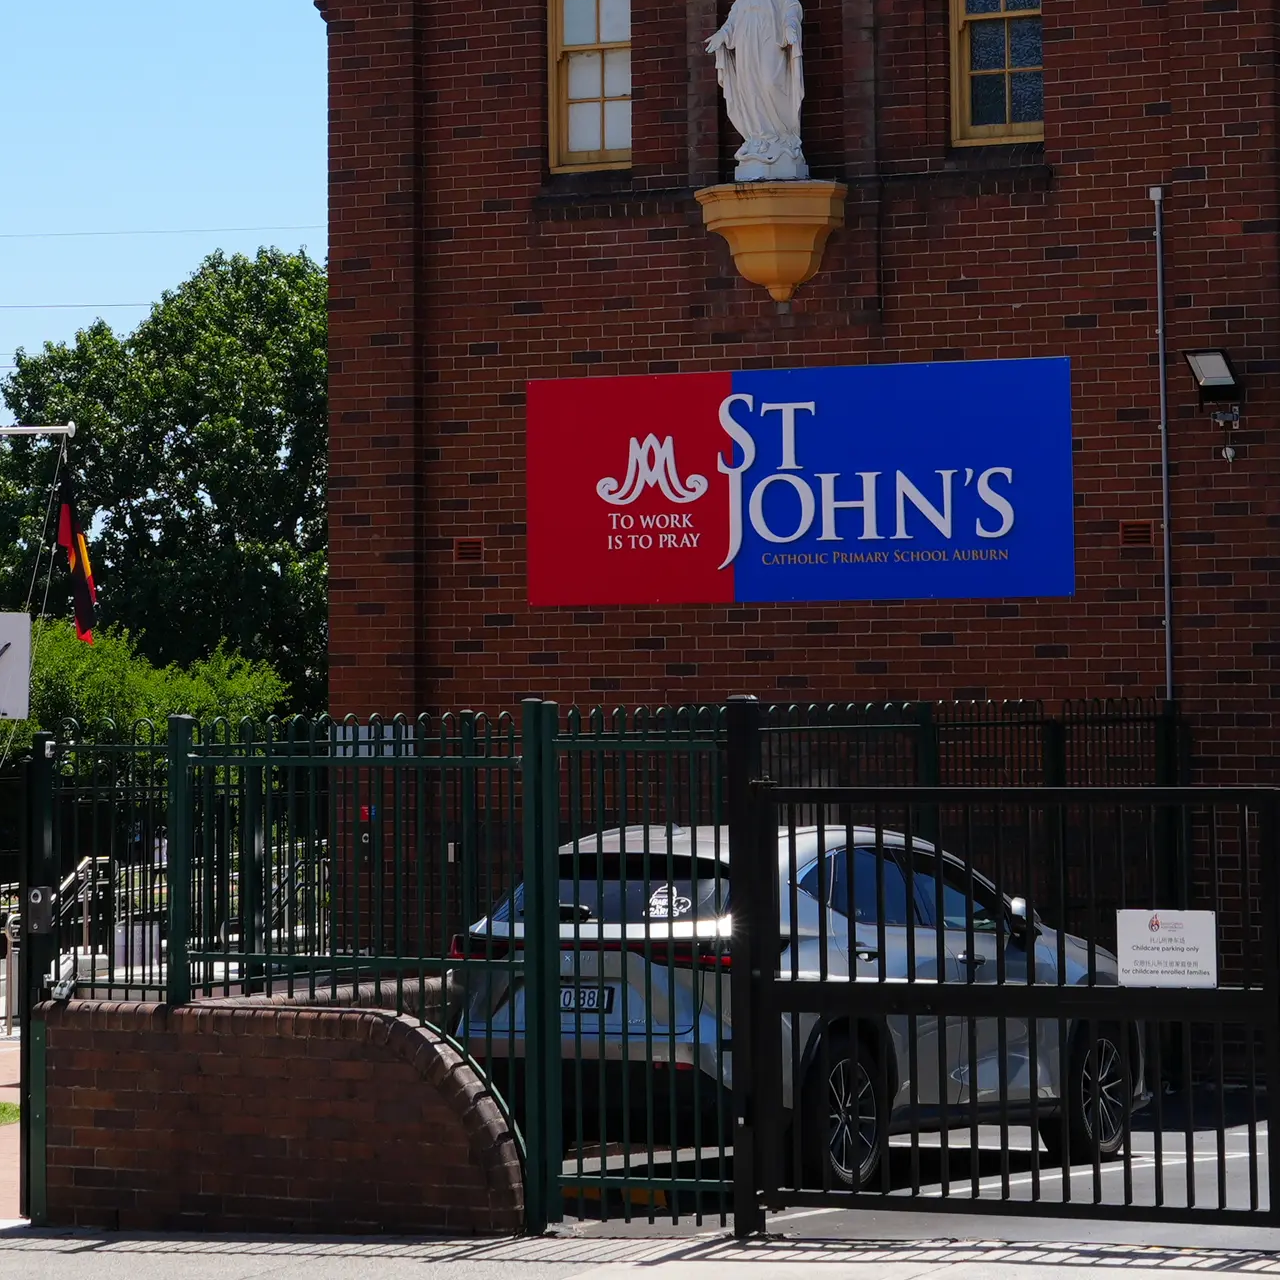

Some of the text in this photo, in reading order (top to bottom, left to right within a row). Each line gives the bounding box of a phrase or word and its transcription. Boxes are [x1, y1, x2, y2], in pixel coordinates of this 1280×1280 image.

[717, 392, 815, 474] ST
[607, 532, 701, 549] IS TO PRAY
[717, 466, 1016, 570] JOHN'S
[761, 547, 1009, 566] CATHOLIC PRIMARY SCHOOL AUBURN
